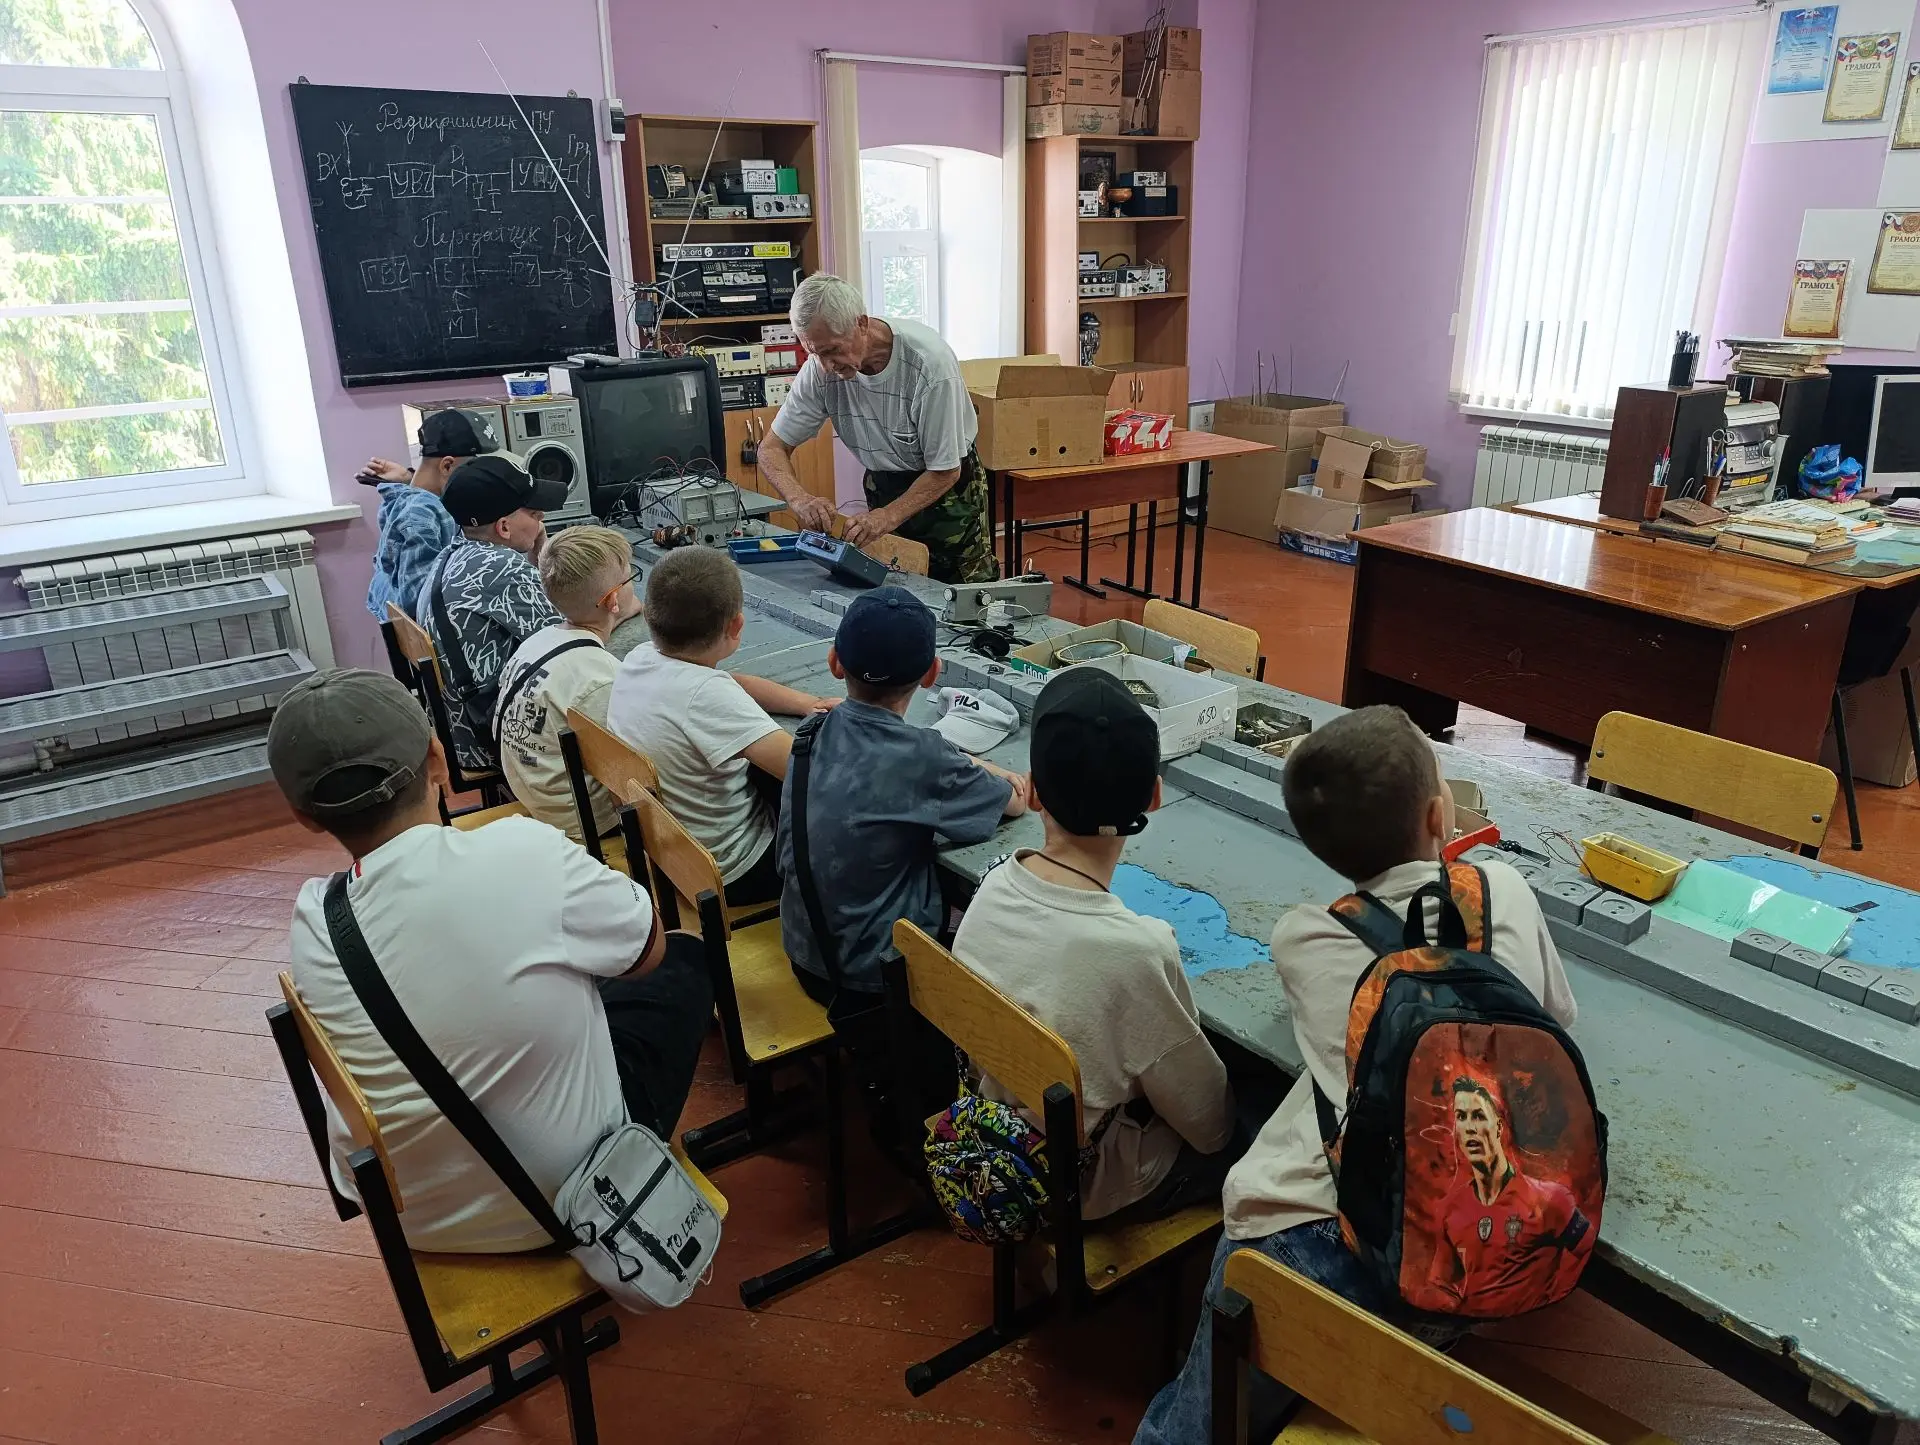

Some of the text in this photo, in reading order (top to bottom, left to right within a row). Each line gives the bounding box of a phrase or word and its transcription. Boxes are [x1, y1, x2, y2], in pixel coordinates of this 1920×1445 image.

[1845, 62, 1882, 71] ГРАМОТА
[1799, 281, 1835, 290] ГРАМОТА
[954, 694, 980, 711] FILA
